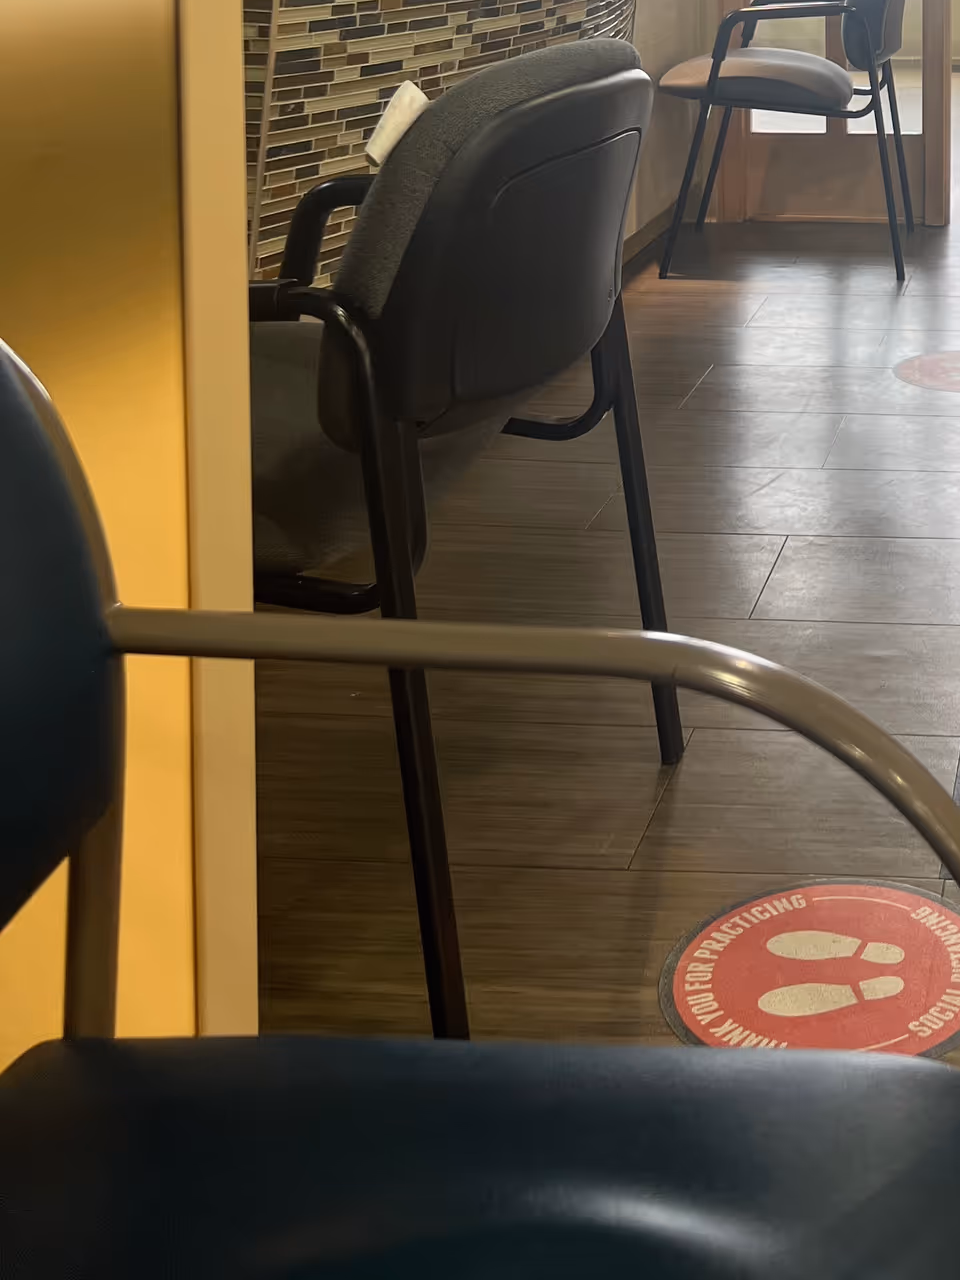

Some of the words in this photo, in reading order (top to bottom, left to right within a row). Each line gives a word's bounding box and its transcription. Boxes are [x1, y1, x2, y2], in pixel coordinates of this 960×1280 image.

[693, 893, 808, 961] PRACTICING
[684, 962, 715, 992] FOR
[686, 992, 725, 1025] YOU
